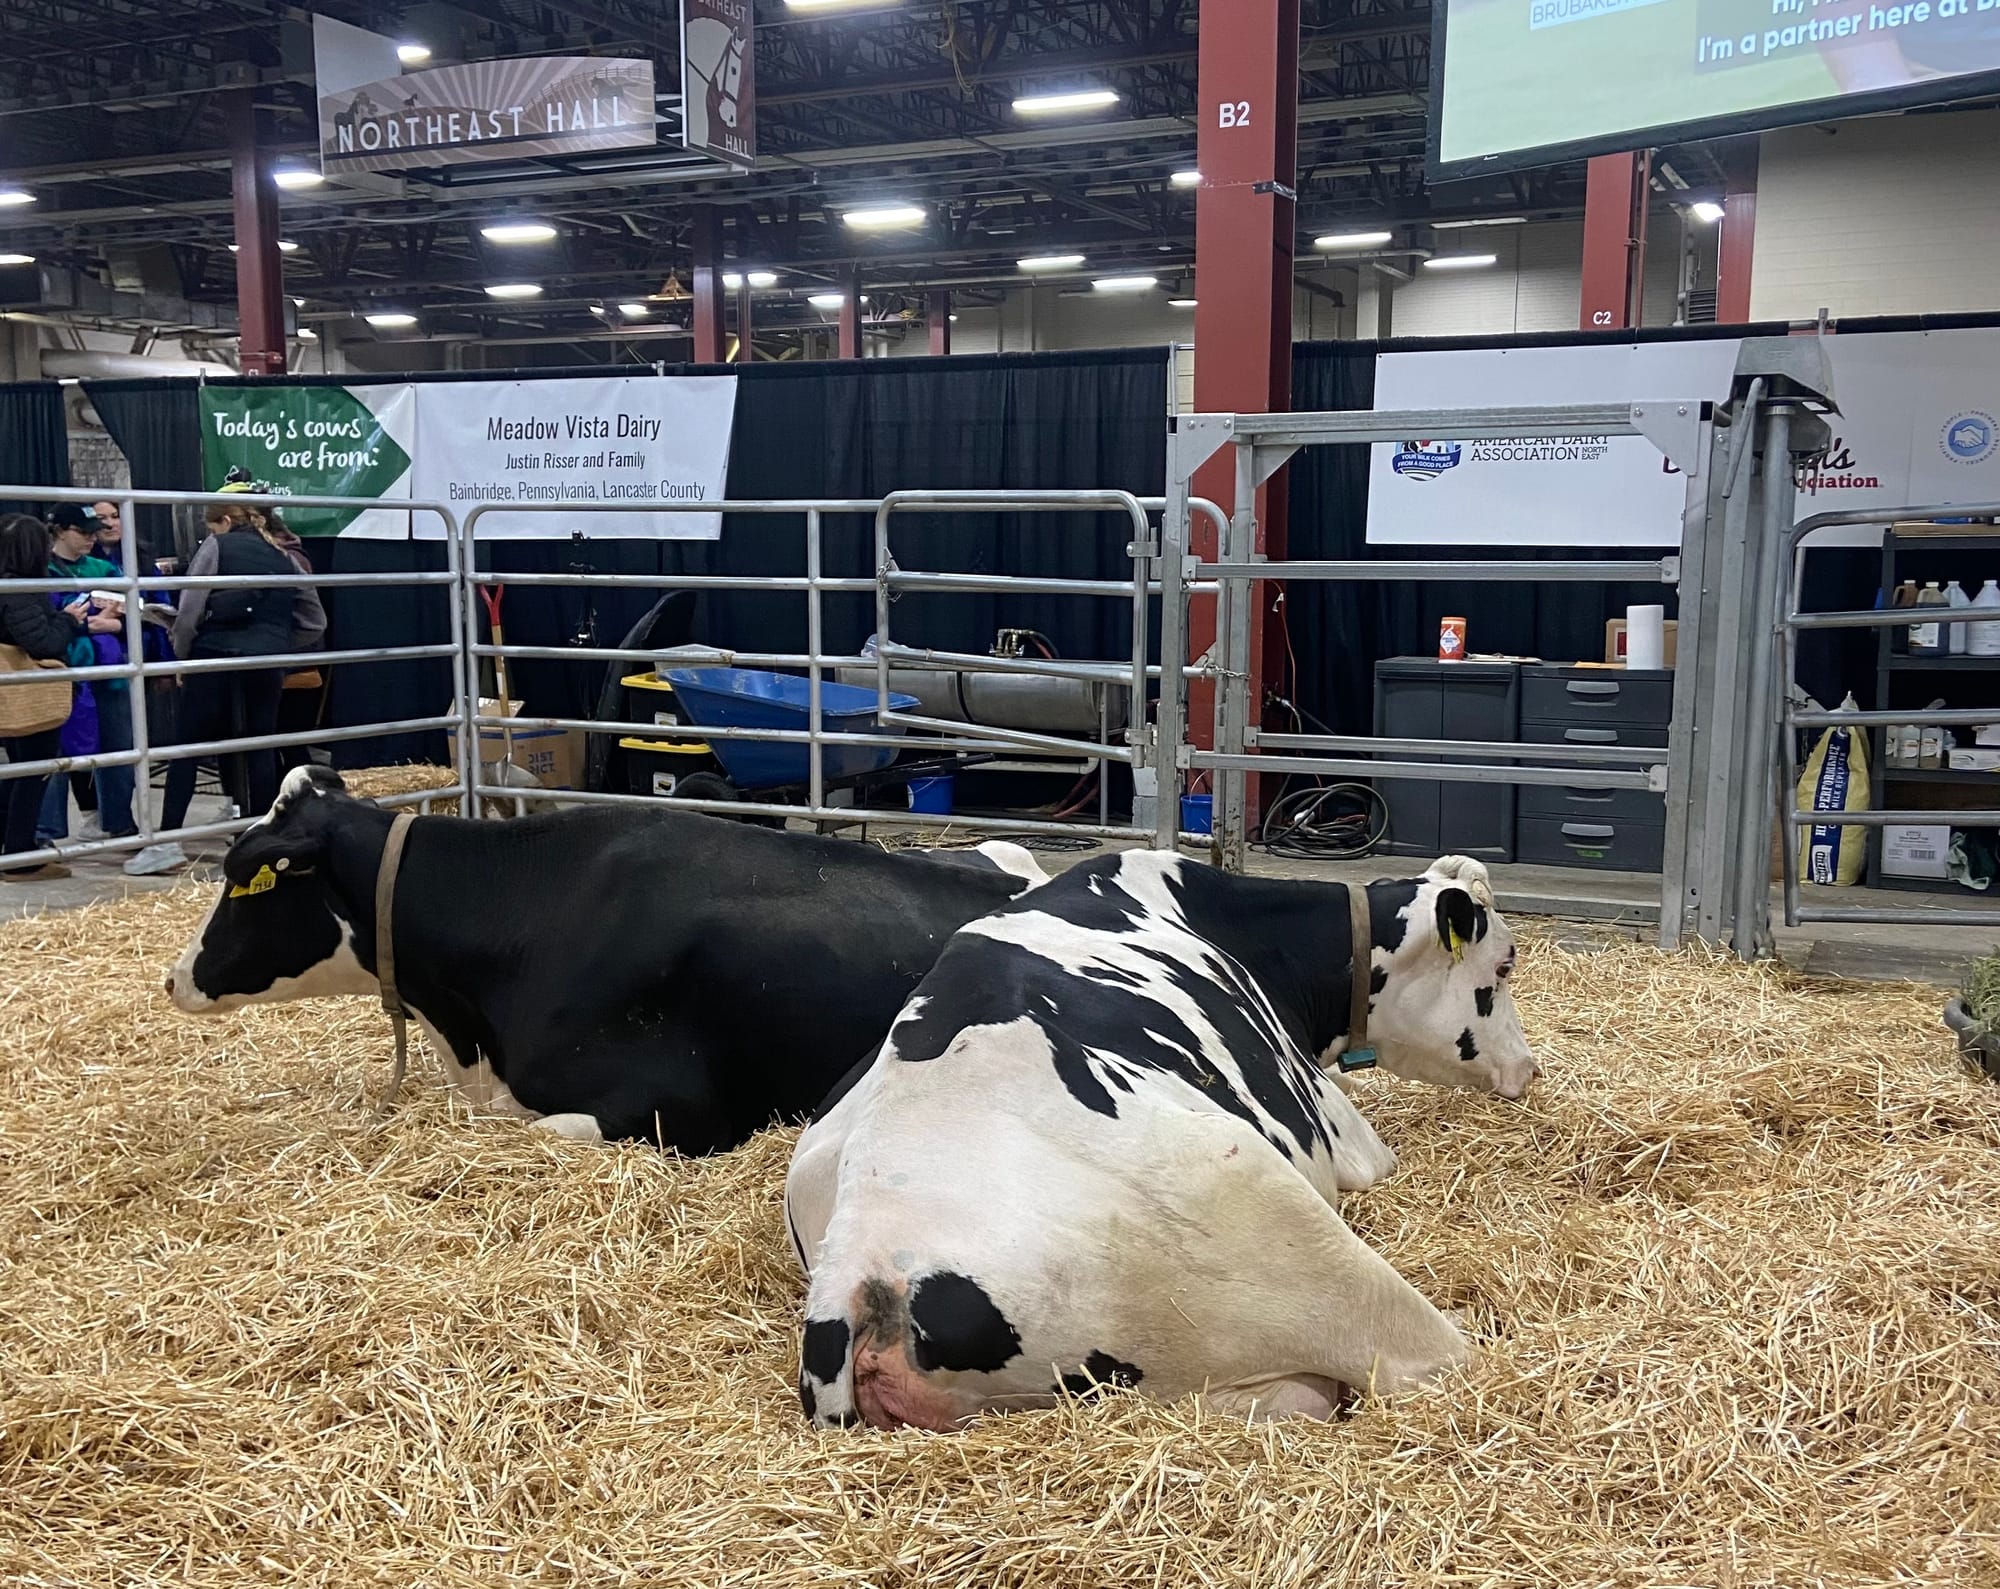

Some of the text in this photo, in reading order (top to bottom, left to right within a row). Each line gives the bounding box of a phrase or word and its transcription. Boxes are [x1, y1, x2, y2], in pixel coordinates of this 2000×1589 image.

[1698, 37, 1733, 62] I'm
[1740, 35, 1757, 54] a
[1762, 14, 1863, 56] partner
[1868, 5, 1931, 31] here
[1938, 0, 1969, 17] at
[338, 96, 627, 153] NORTHEAST HALL
[1219, 101, 1250, 128] B2
[725, 133, 753, 158] HALL
[1592, 311, 1612, 325] C2
[213, 410, 362, 451] Today's cows
[487, 414, 662, 441] Meadow Vista Dairy
[278, 441, 380, 471] are from:
[505, 451, 646, 470] Justin Risser and Family
[1470, 446, 1579, 461] ASSOCIATION
[1581, 446, 1608, 454] NORTH
[1581, 453, 1601, 461] EAST
[449, 479, 706, 501] Bainbridge, Pennsylvania, Lancaster County
[1831, 790, 1842, 809] MILK
